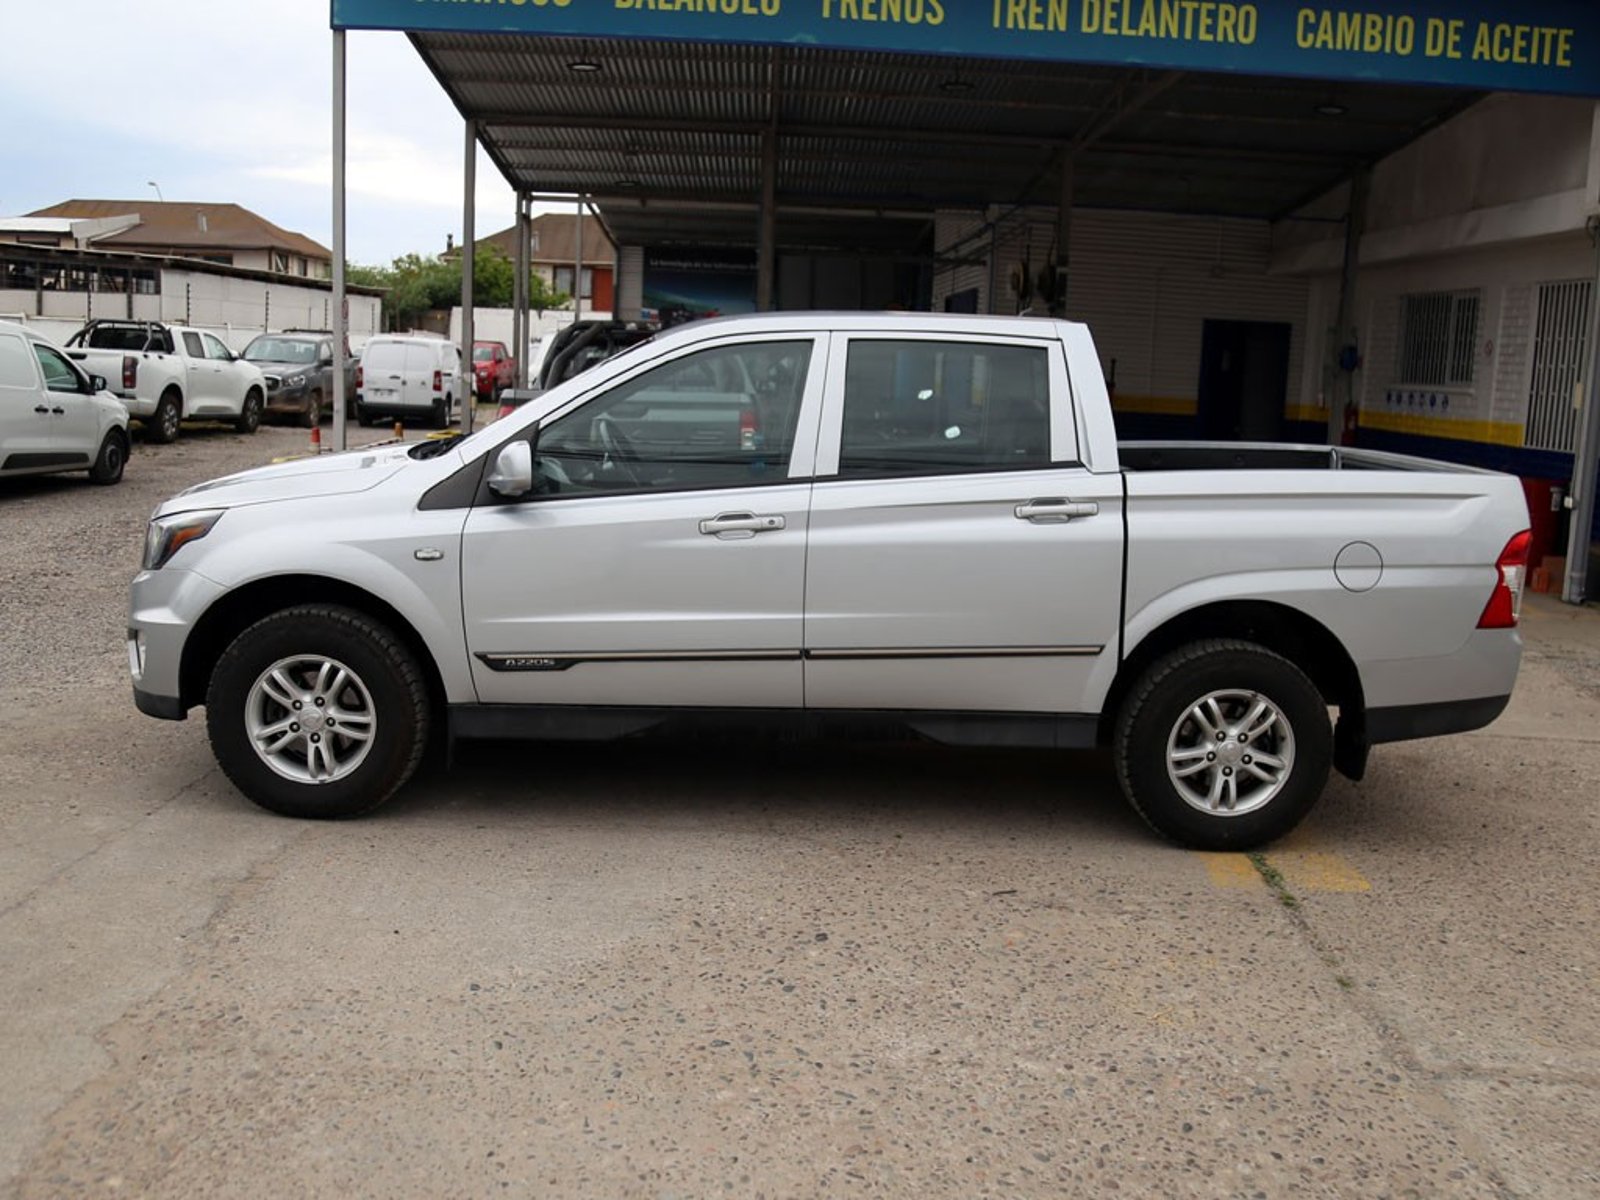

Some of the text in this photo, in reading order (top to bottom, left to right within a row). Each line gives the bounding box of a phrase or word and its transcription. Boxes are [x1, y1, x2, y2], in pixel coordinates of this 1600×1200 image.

[1081, 0, 1257, 45] DELANTERO
[1295, 8, 1574, 67] CAMBIO DE ACEITE
